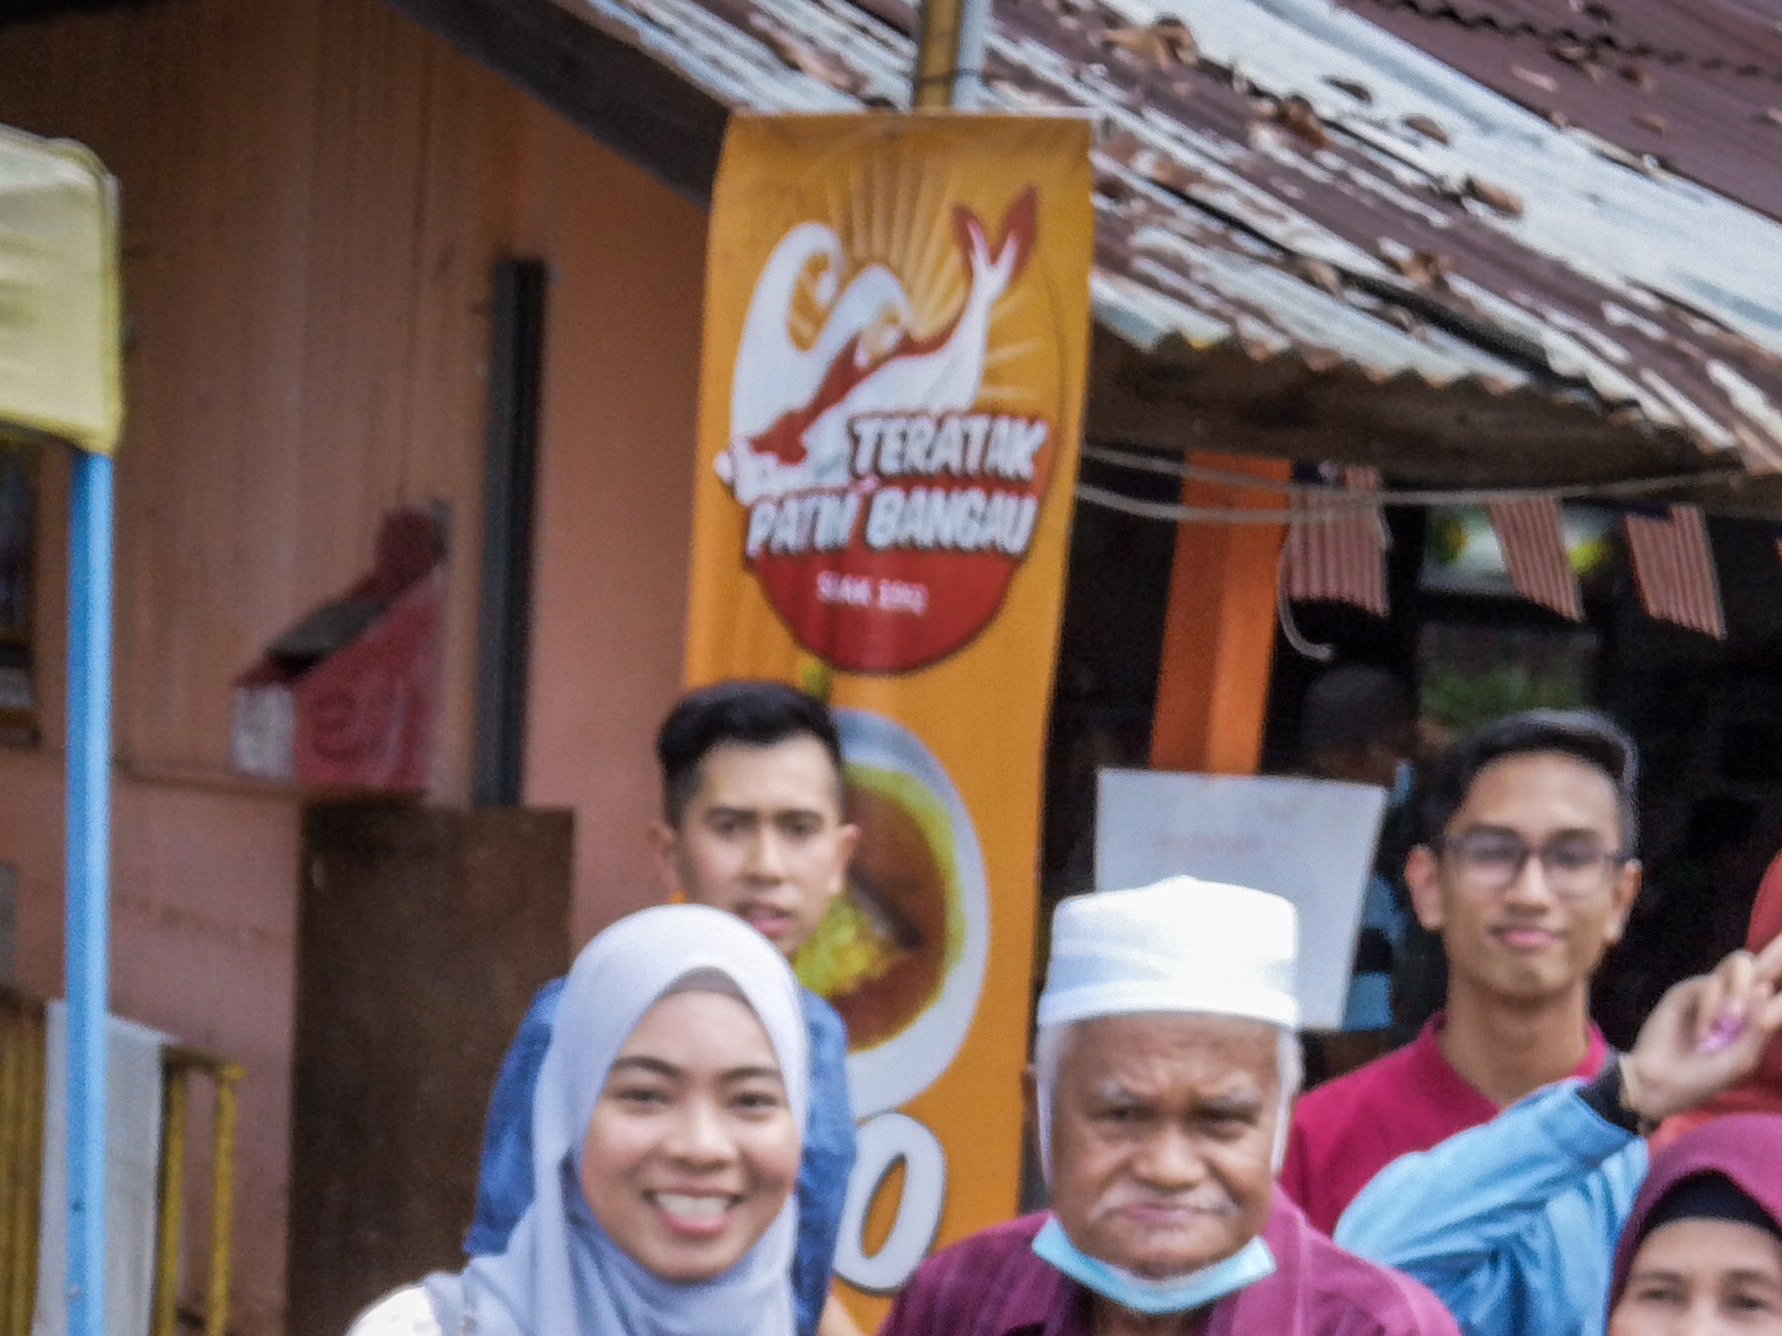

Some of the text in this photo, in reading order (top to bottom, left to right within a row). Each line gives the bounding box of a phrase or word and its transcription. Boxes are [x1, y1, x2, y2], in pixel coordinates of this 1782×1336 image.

[850, 413, 1049, 481] TERATAK
[745, 486, 1038, 558] PATIN BANGAU
